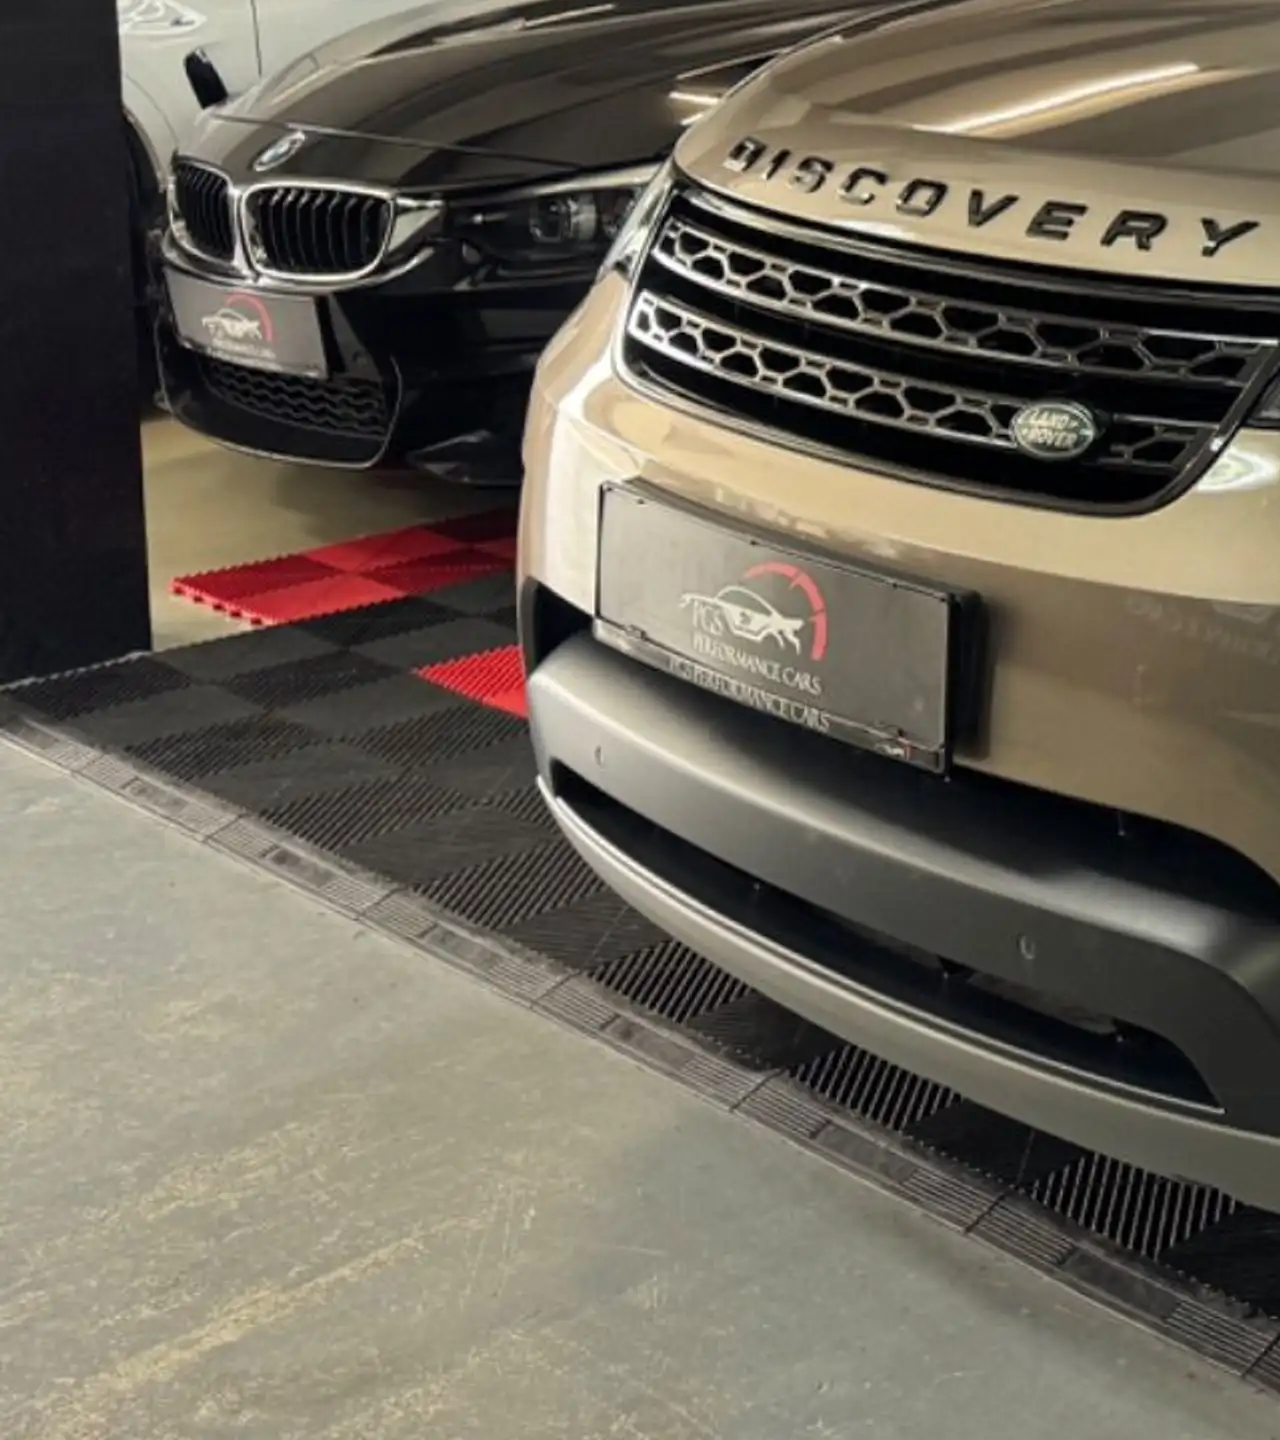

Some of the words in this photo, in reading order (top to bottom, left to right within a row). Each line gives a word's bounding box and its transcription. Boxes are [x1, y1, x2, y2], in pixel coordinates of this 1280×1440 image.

[723, 137, 1260, 257] DISCOVERY
[1027, 428, 1078, 448] ROVER
[1028, 409, 1070, 429] LAND
[693, 632, 781, 682] PERFORMANCE
[782, 666, 822, 695] CARS
[693, 664, 789, 716] PERFORMANCE
[790, 698, 831, 732] CARS
